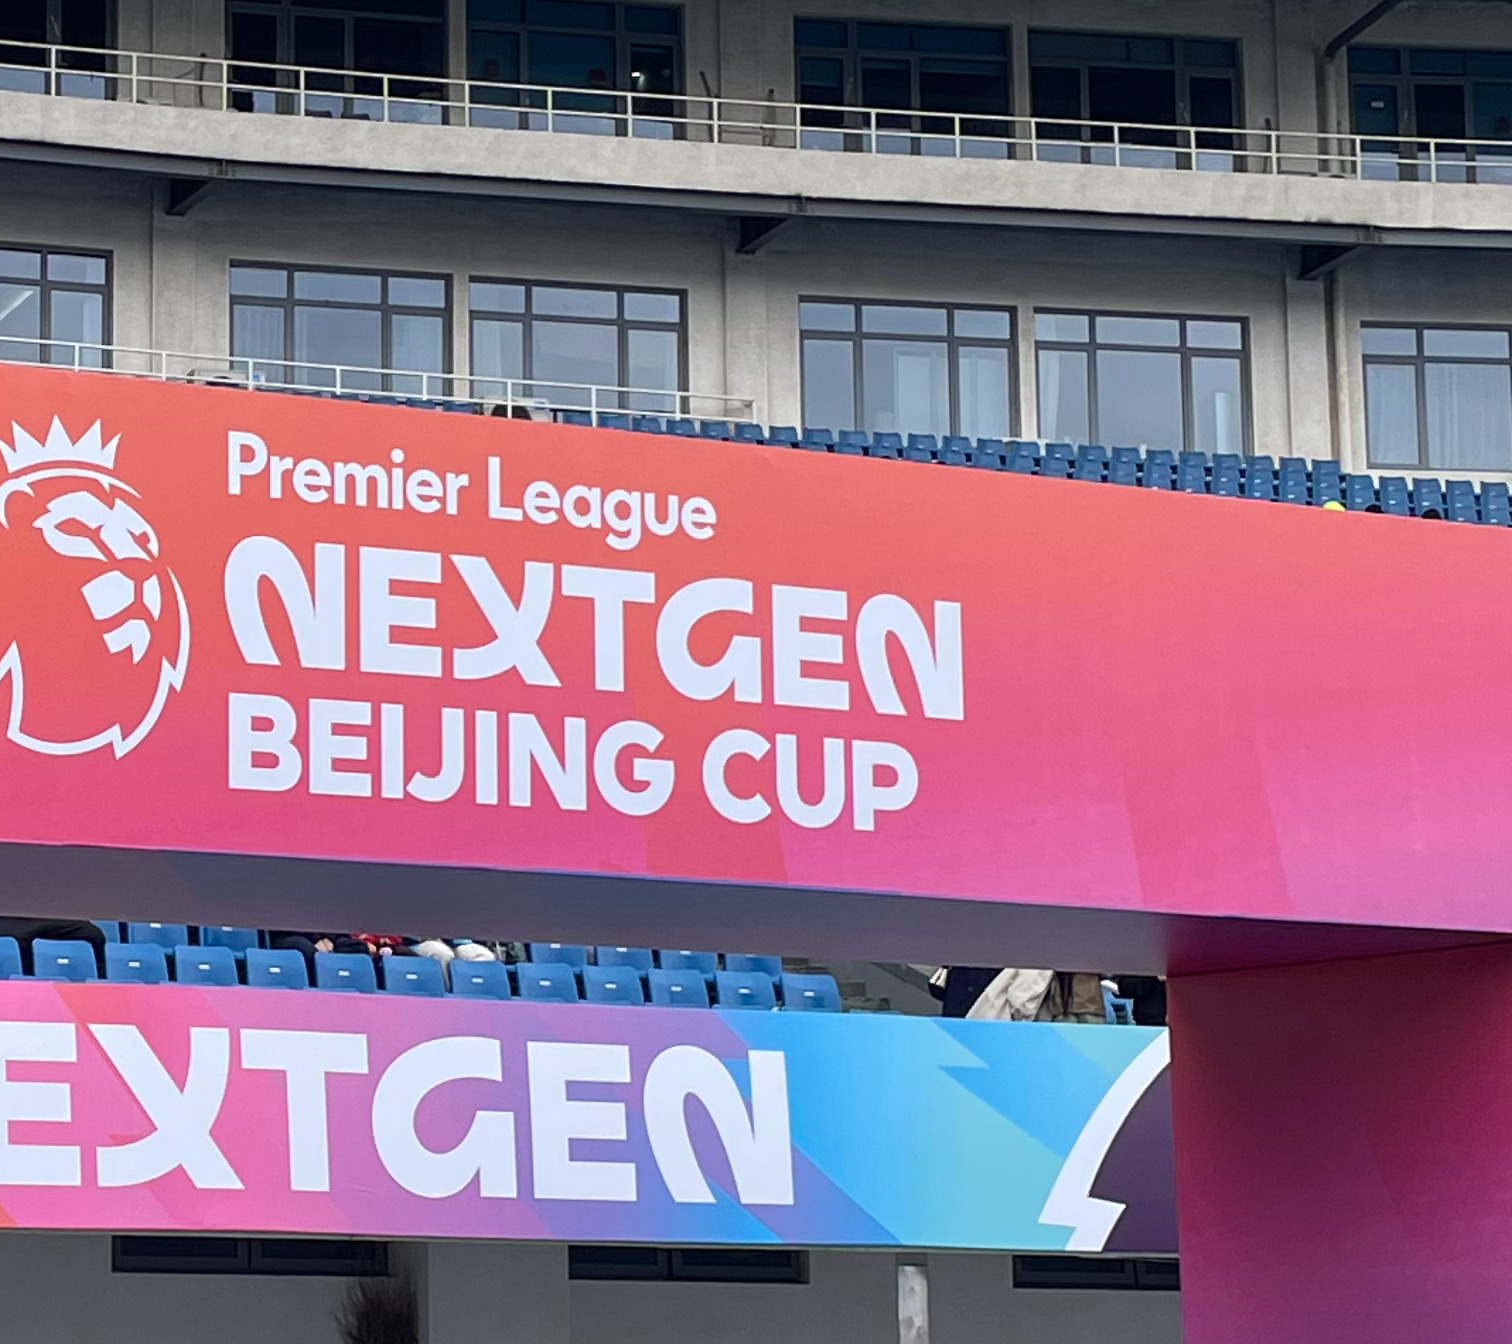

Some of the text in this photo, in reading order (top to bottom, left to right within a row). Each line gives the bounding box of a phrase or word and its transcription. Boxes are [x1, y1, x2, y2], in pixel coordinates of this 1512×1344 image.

[226, 430, 718, 552] Premier League
[224, 535, 964, 721] NEXTGEN
[228, 692, 920, 832] BEIJING CUP
